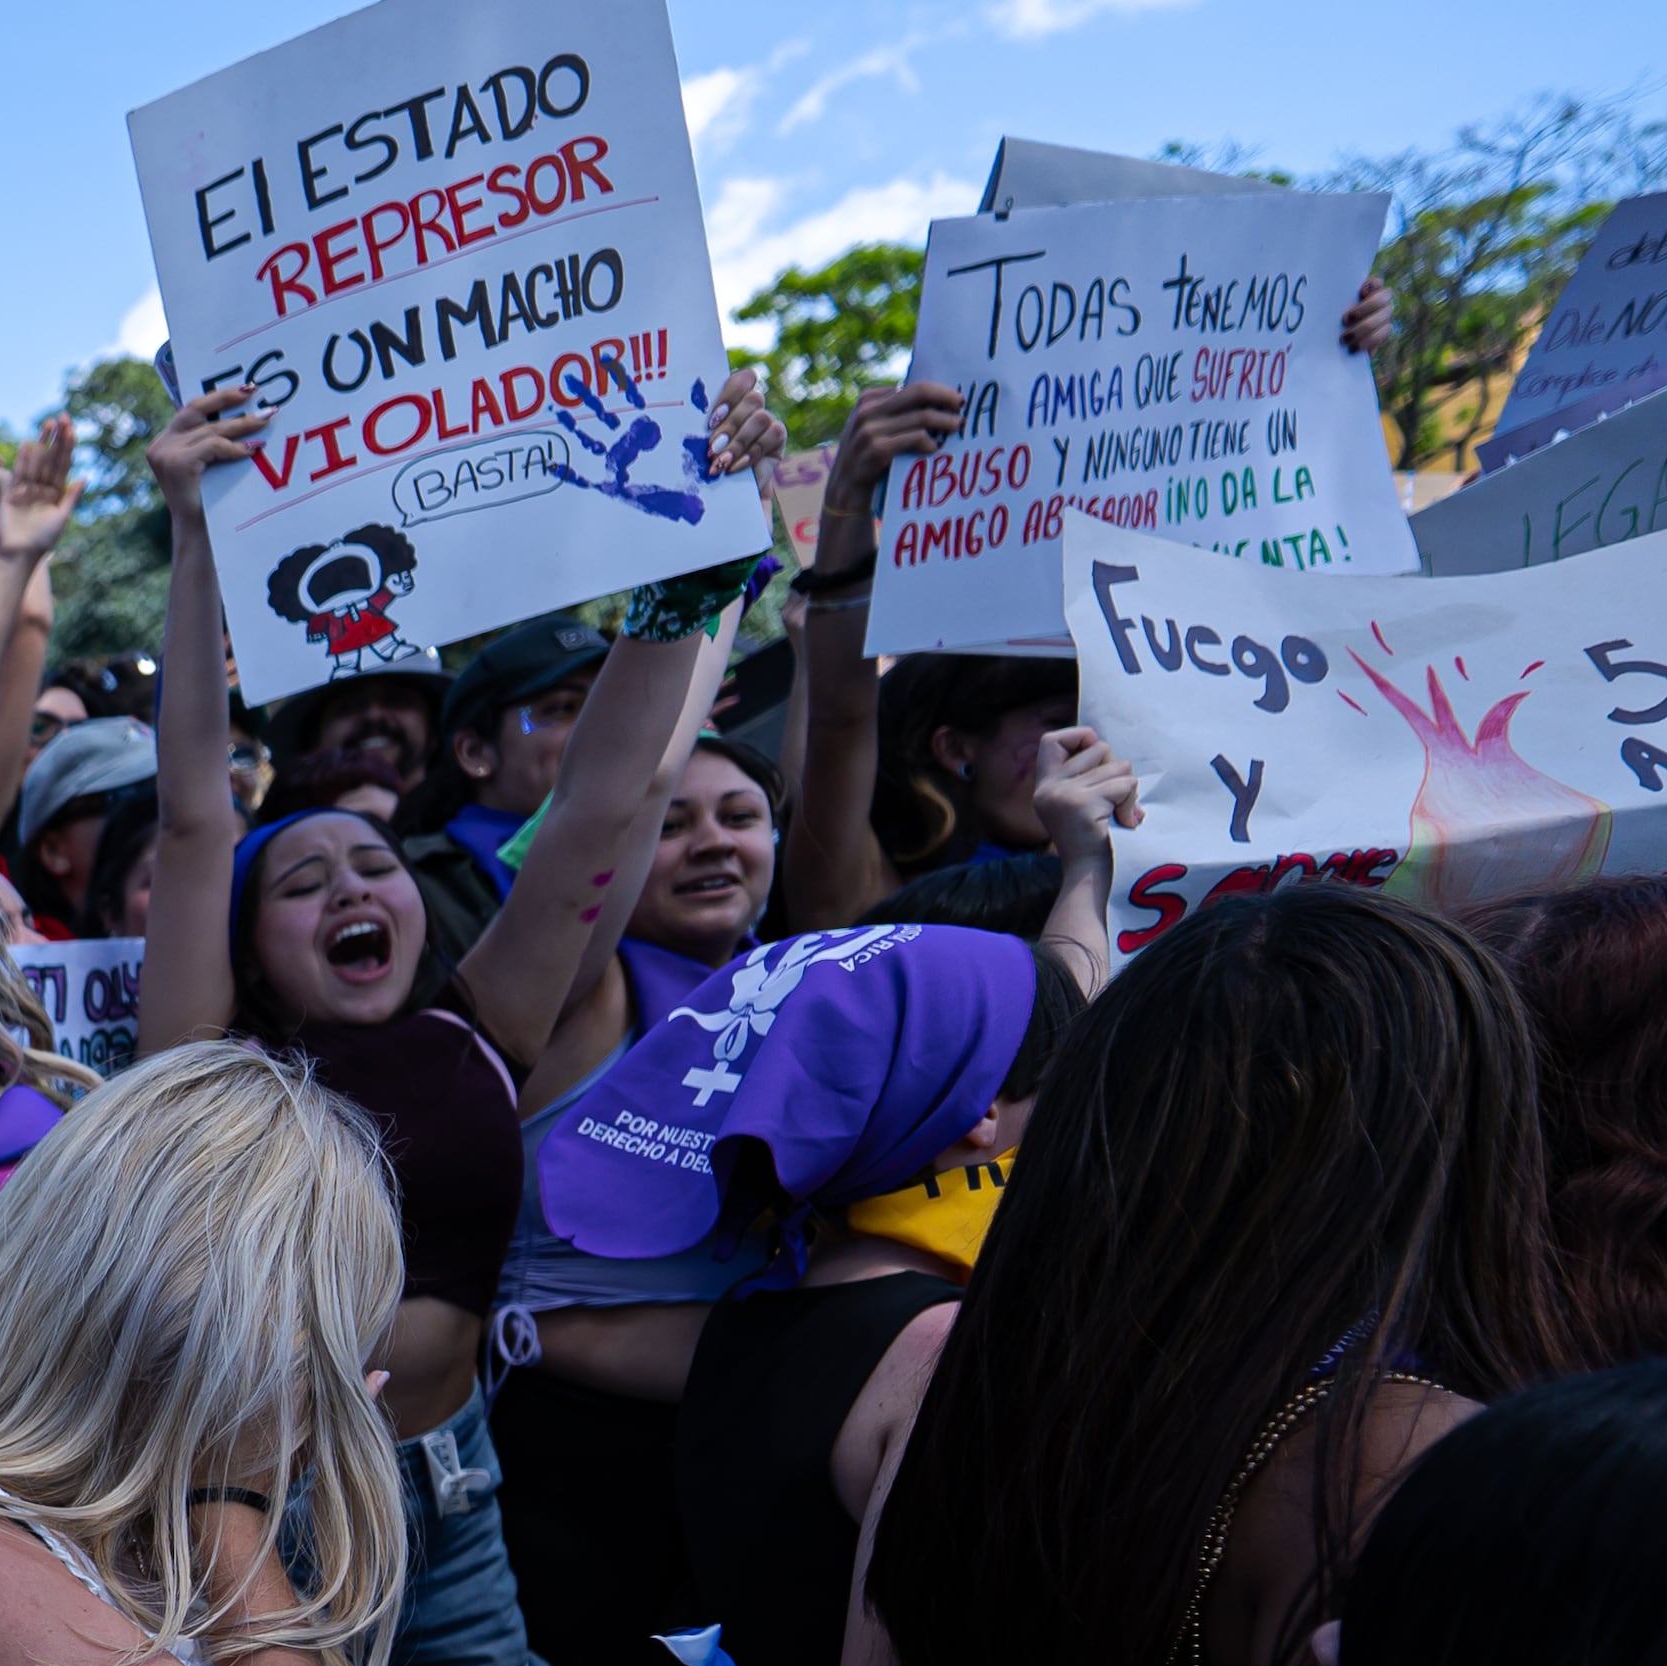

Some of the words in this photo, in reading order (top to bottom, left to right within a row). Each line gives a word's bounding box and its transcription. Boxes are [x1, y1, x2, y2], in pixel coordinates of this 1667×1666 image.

[296, 53, 590, 212] ESTADO
[256, 135, 615, 319] REPRESOR
[322, 306, 429, 393] UN
[435, 248, 623, 361] MACHO
[947, 251, 1141, 360] TODAS
[249, 328, 669, 491] VIOLADOR!!!
[929, 379, 1000, 449] NA
[1028, 365, 1124, 428] AMIGA
[1134, 349, 1184, 411] QUE
[1190, 342, 1294, 402] SUFRIÓ
[413, 439, 556, 512] BASTA!
[902, 444, 1031, 511] ABUSO
[1053, 435, 1072, 489] Y
[1083, 422, 1183, 483] NINGUNO
[1188, 418, 1252, 461] TIENE
[1267, 408, 1299, 457] UN
[894, 504, 1009, 569] AMIGO
[1222, 465, 1257, 516] DA
[1273, 465, 1315, 504] LA
[1092, 560, 1329, 714] Fuego
[577, 1116, 667, 1161] DERECHO
[665, 1147, 681, 1166] A
[615, 1109, 659, 1138] POR
